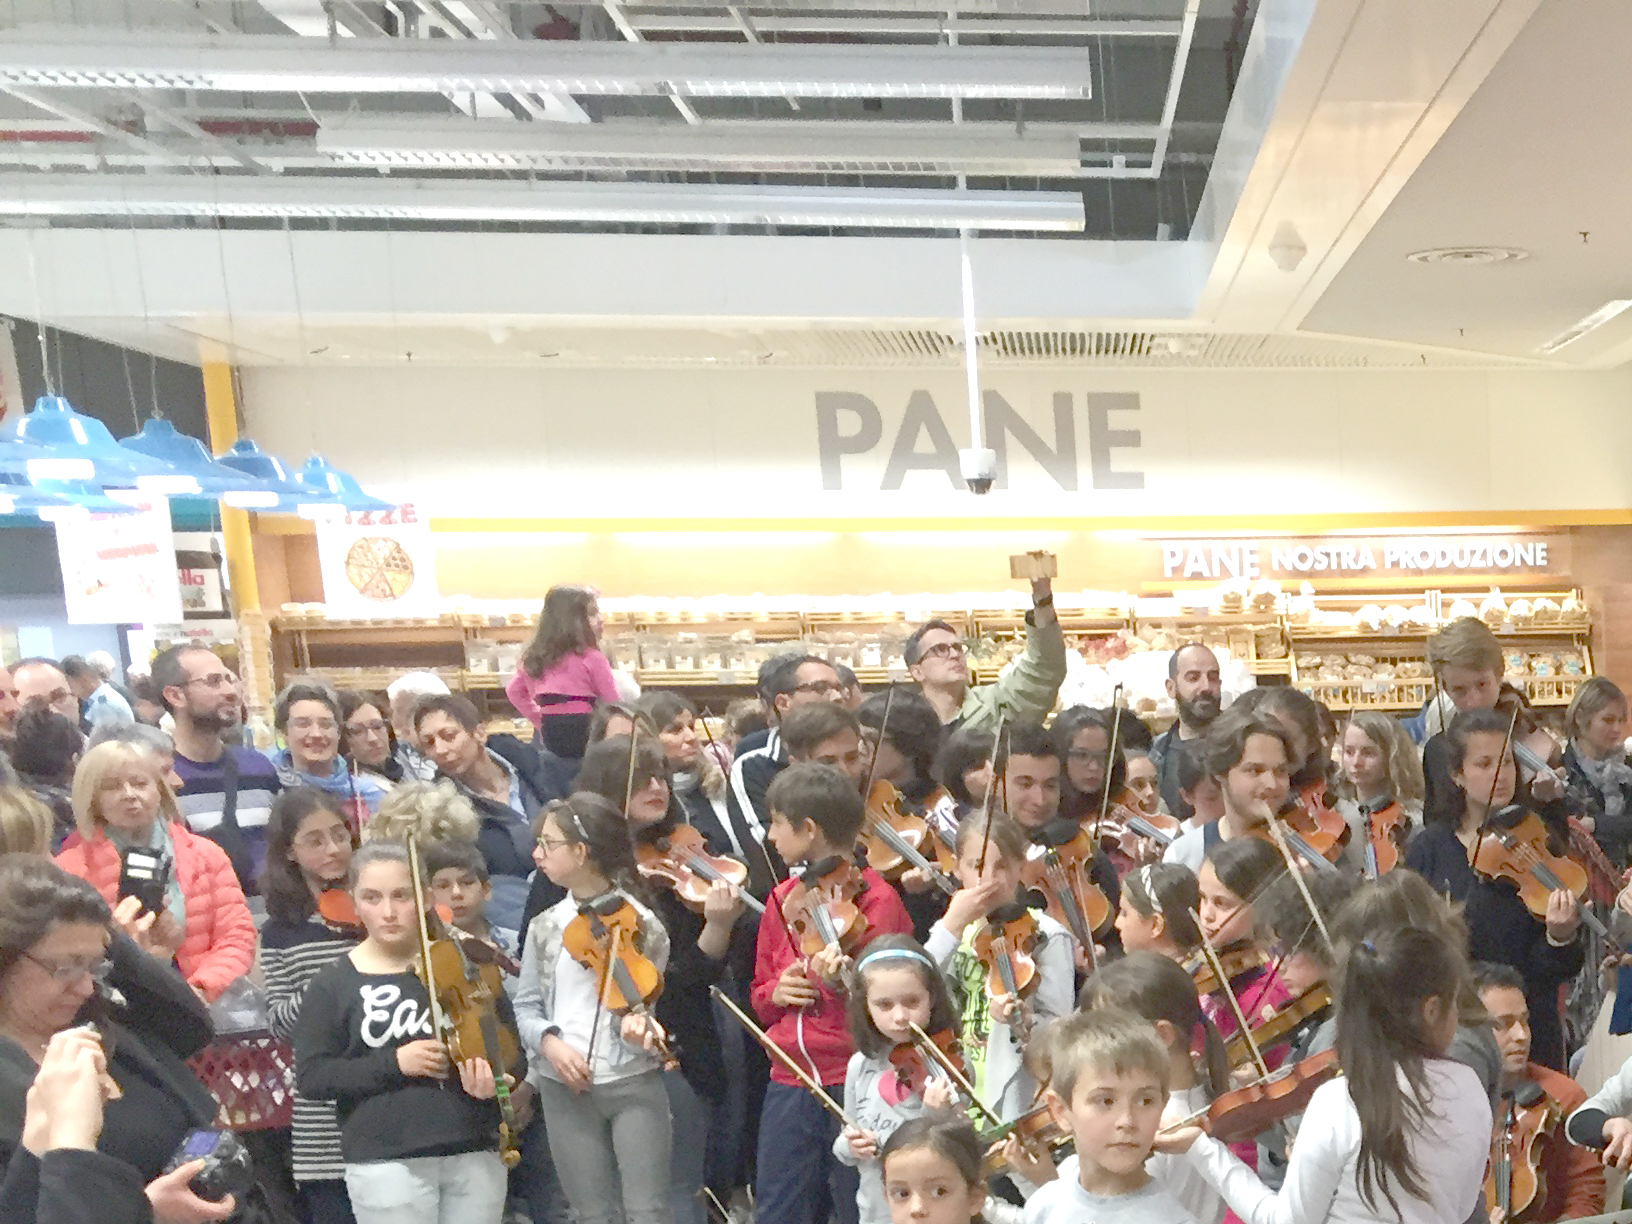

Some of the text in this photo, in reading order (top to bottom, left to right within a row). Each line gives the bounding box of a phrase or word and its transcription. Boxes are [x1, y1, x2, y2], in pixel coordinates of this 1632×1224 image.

[815, 389, 1145, 491] PANE
[1161, 541, 1548, 578] PANE NOSTRA PRODUZIONE
